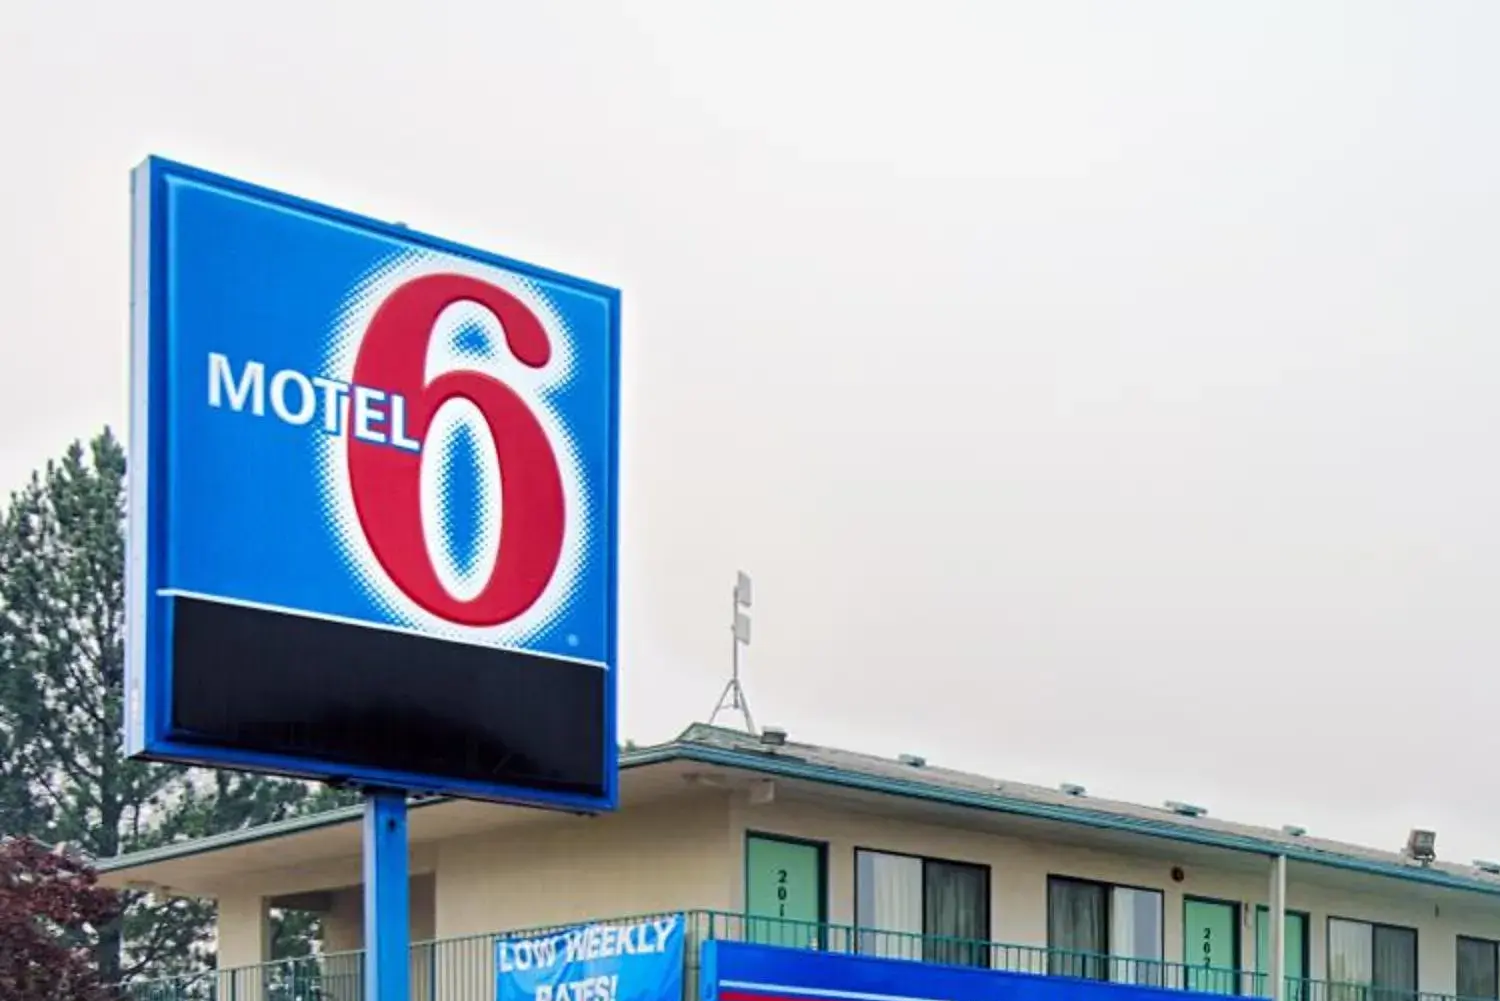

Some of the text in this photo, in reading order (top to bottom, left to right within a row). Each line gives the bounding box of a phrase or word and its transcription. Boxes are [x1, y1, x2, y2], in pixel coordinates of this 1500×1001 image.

[207, 272, 567, 628] MOTEL 6
[499, 914, 678, 973] LOW WEEKLY
